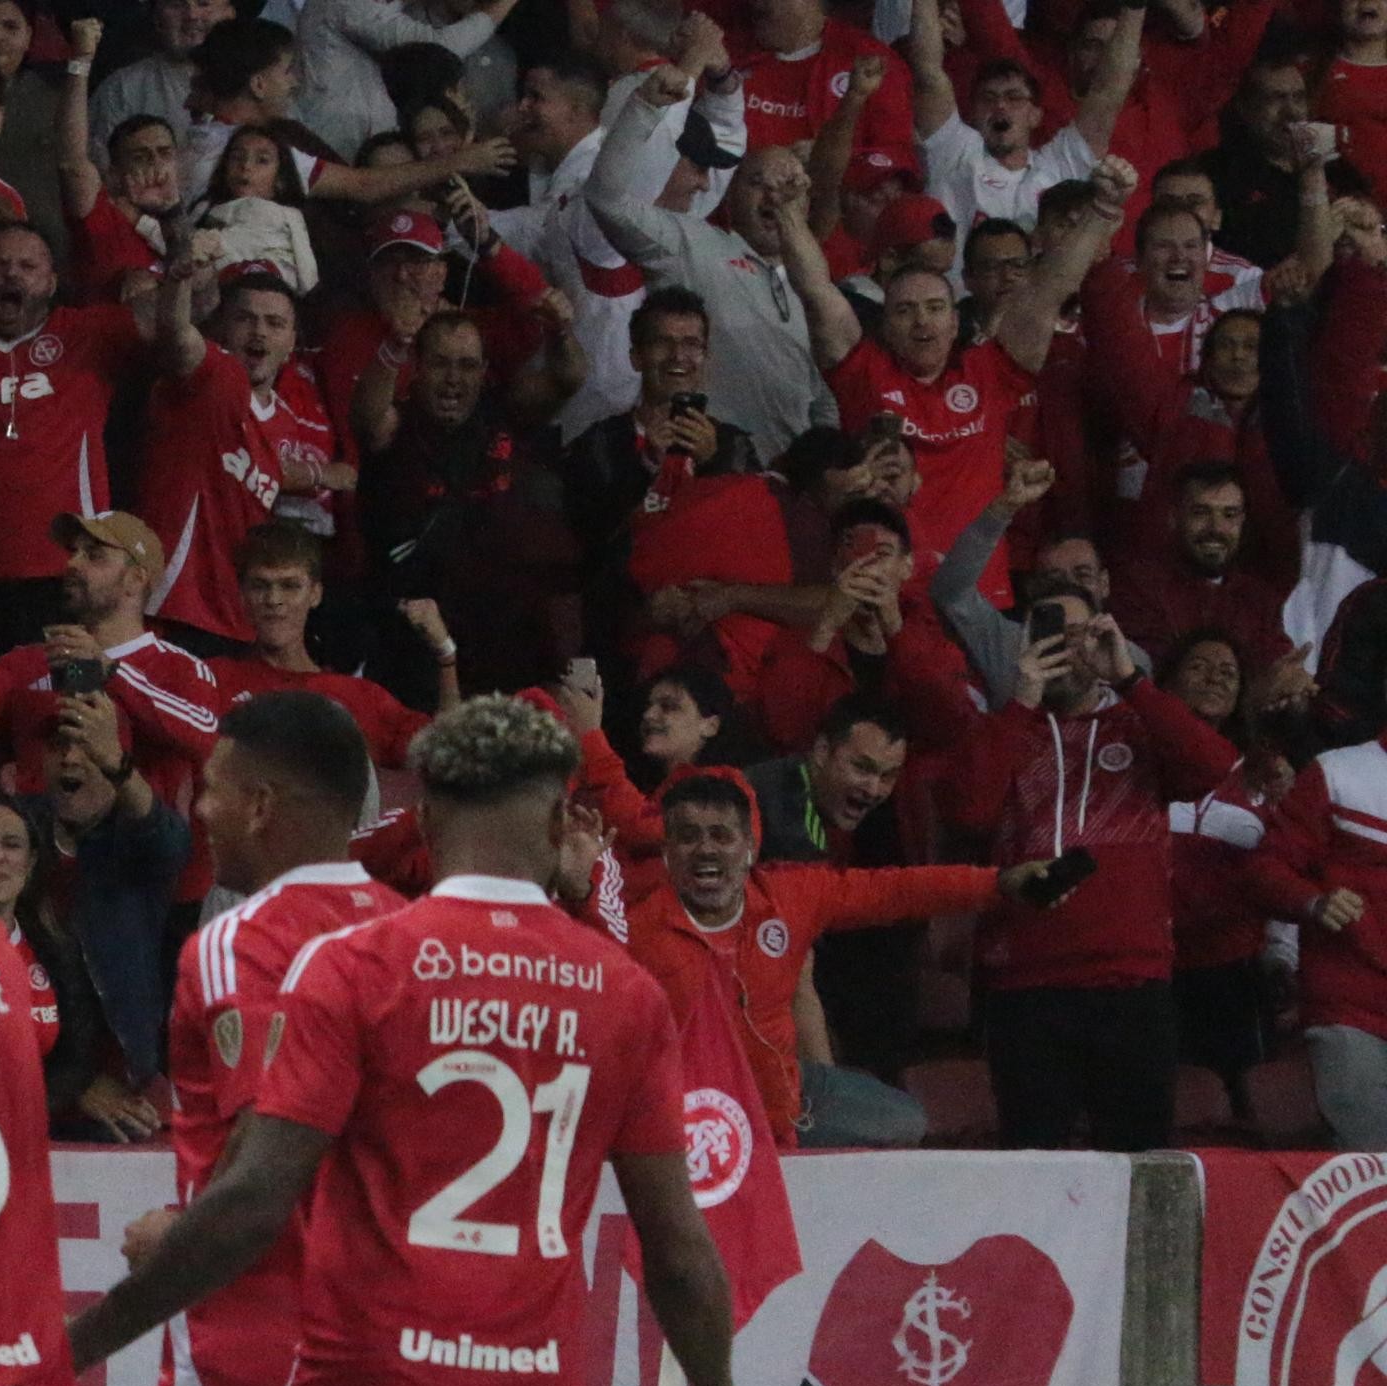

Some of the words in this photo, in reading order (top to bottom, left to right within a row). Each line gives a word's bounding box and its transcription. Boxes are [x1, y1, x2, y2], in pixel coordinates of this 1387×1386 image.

[746, 94, 805, 118] banris
[460, 943, 603, 993] banrisul
[429, 997, 549, 1052] WESLEY
[555, 1008, 586, 1057] R.
[407, 1050, 591, 1259] 21
[399, 1327, 560, 1375] Unimed
